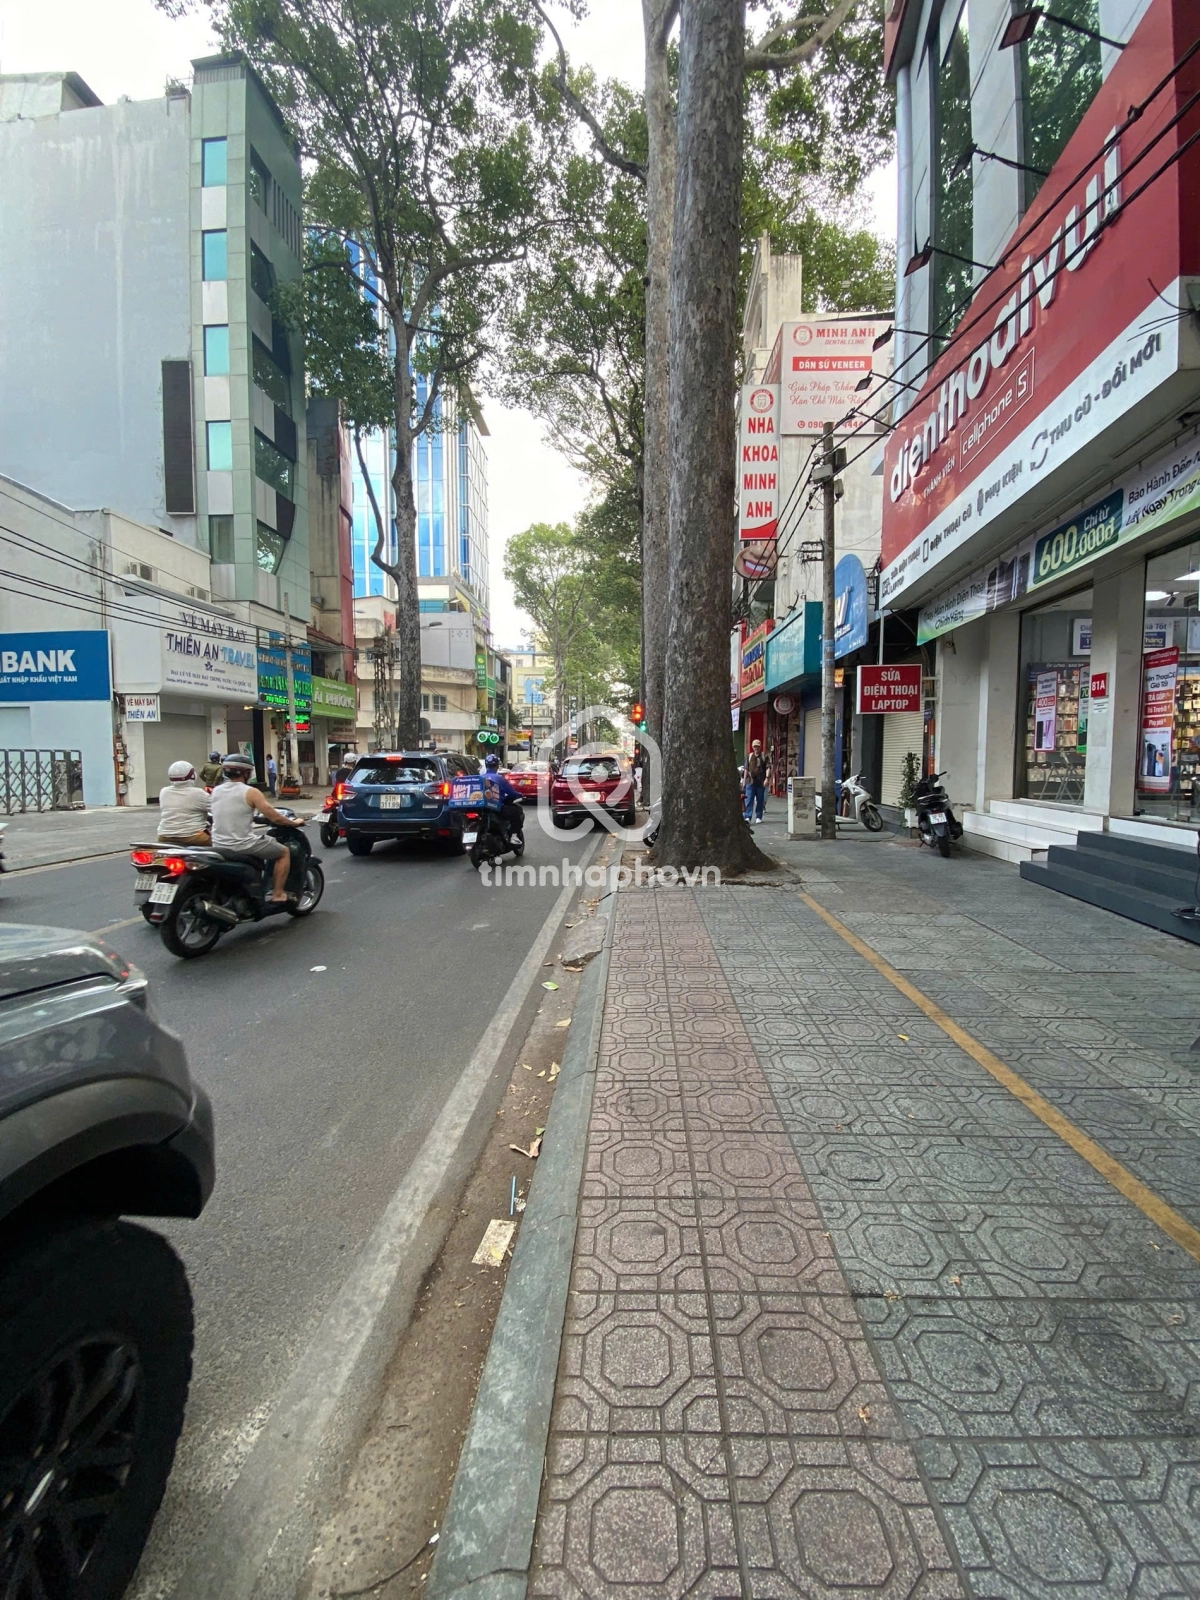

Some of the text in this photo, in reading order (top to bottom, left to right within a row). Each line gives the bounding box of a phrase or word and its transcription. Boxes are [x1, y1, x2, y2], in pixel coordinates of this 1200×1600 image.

[890, 125, 1122, 502] dienthoaivui
[816, 328, 848, 337] MINH
[851, 328, 875, 337] ANH
[799, 358, 865, 369] DÁN SỨ VENEER
[1050, 414, 1072, 445] THU
[1074, 394, 1092, 422] CŨ
[1101, 361, 1127, 399] ĐỔI
[1130, 333, 1161, 374] MỚI
[748, 417, 774, 434] NHA
[962, 387, 1013, 456] cellphone
[743, 445, 778, 462] KHOA
[743, 473, 777, 490] MINH
[923, 455, 955, 499] THÀNH VIÊN
[984, 460, 1023, 503] PHỤ KIỆN
[1128, 488, 1145, 505] Bảo
[1147, 470, 1171, 494] Hành
[1172, 455, 1192, 478] Đến
[1142, 496, 1167, 518] Ngay
[1167, 479, 1197, 502] Trong
[746, 501, 773, 518] ANH
[943, 518, 961, 539] THOẠI
[962, 504, 972, 523] CŨ
[1039, 516, 1115, 576] 600.000đ
[166, 633, 200, 656] THIÊN
[203, 642, 219, 660] AN
[221, 646, 255, 669] TRAVEL
[12, 675, 29, 685] NHẬP
[30, 674, 47, 683] KHẨU
[48, 674, 62, 684] VIỆT
[881, 668, 901, 681] SỬA
[864, 683, 918, 698] ĐIỆN THOẠI
[1092, 680, 1105, 691] 81A
[146, 698, 155, 706] BAY
[872, 699, 909, 710] LAPTOP
[128, 709, 156, 719] THIÊN AN
